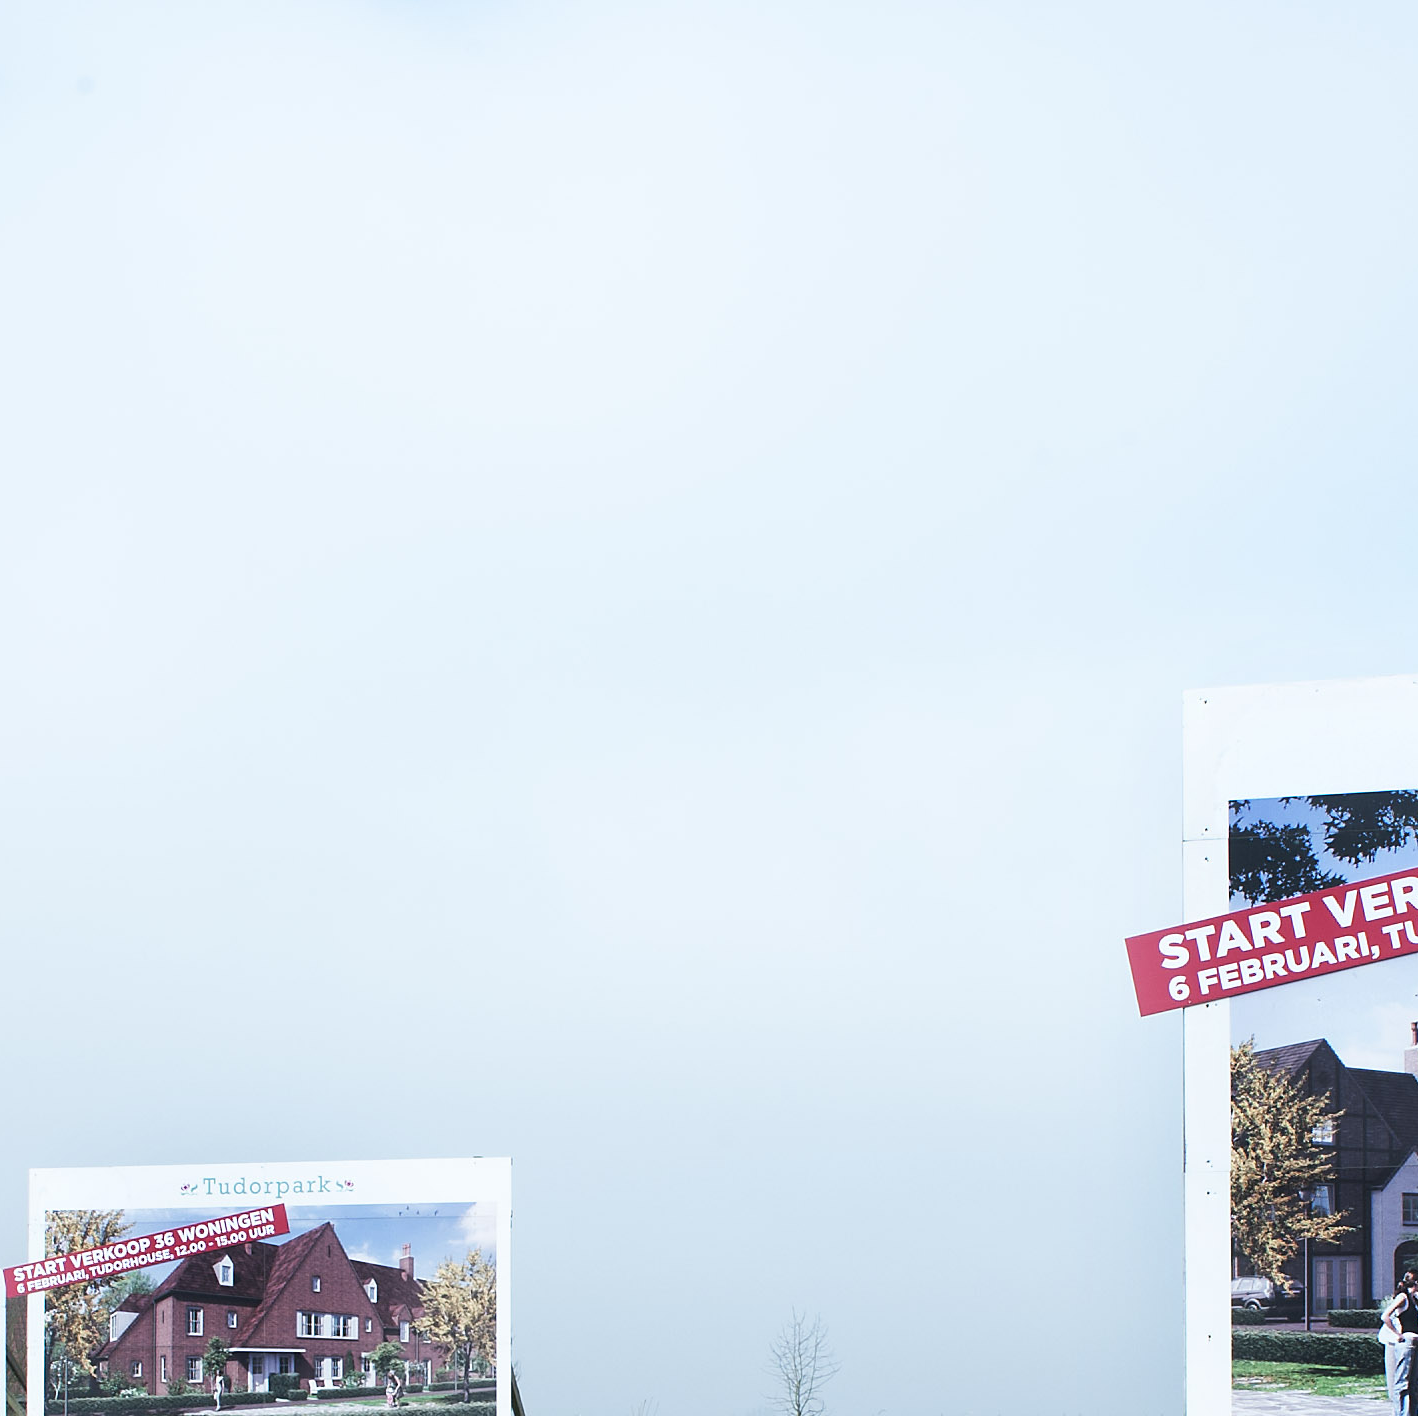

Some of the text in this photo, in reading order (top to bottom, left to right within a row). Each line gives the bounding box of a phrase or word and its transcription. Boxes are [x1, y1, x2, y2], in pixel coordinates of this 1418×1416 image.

[1158, 901, 1311, 970] START
[1168, 975, 1190, 1001] 6
[1197, 931, 1380, 996] FEBRUARI,
[203, 1175, 331, 1199] Tudorpark
[13, 1208, 275, 1282] START VERKOOP 36 WONINGEN
[16, 1282, 25, 1294] 6
[27, 1269, 89, 1292] FEBRUARI,
[89, 1248, 174, 1277] TUDORHOUSE,
[175, 1240, 206, 1256] 12.00
[215, 1230, 247, 1247] 15.00
[248, 1224, 275, 1239] UUR
